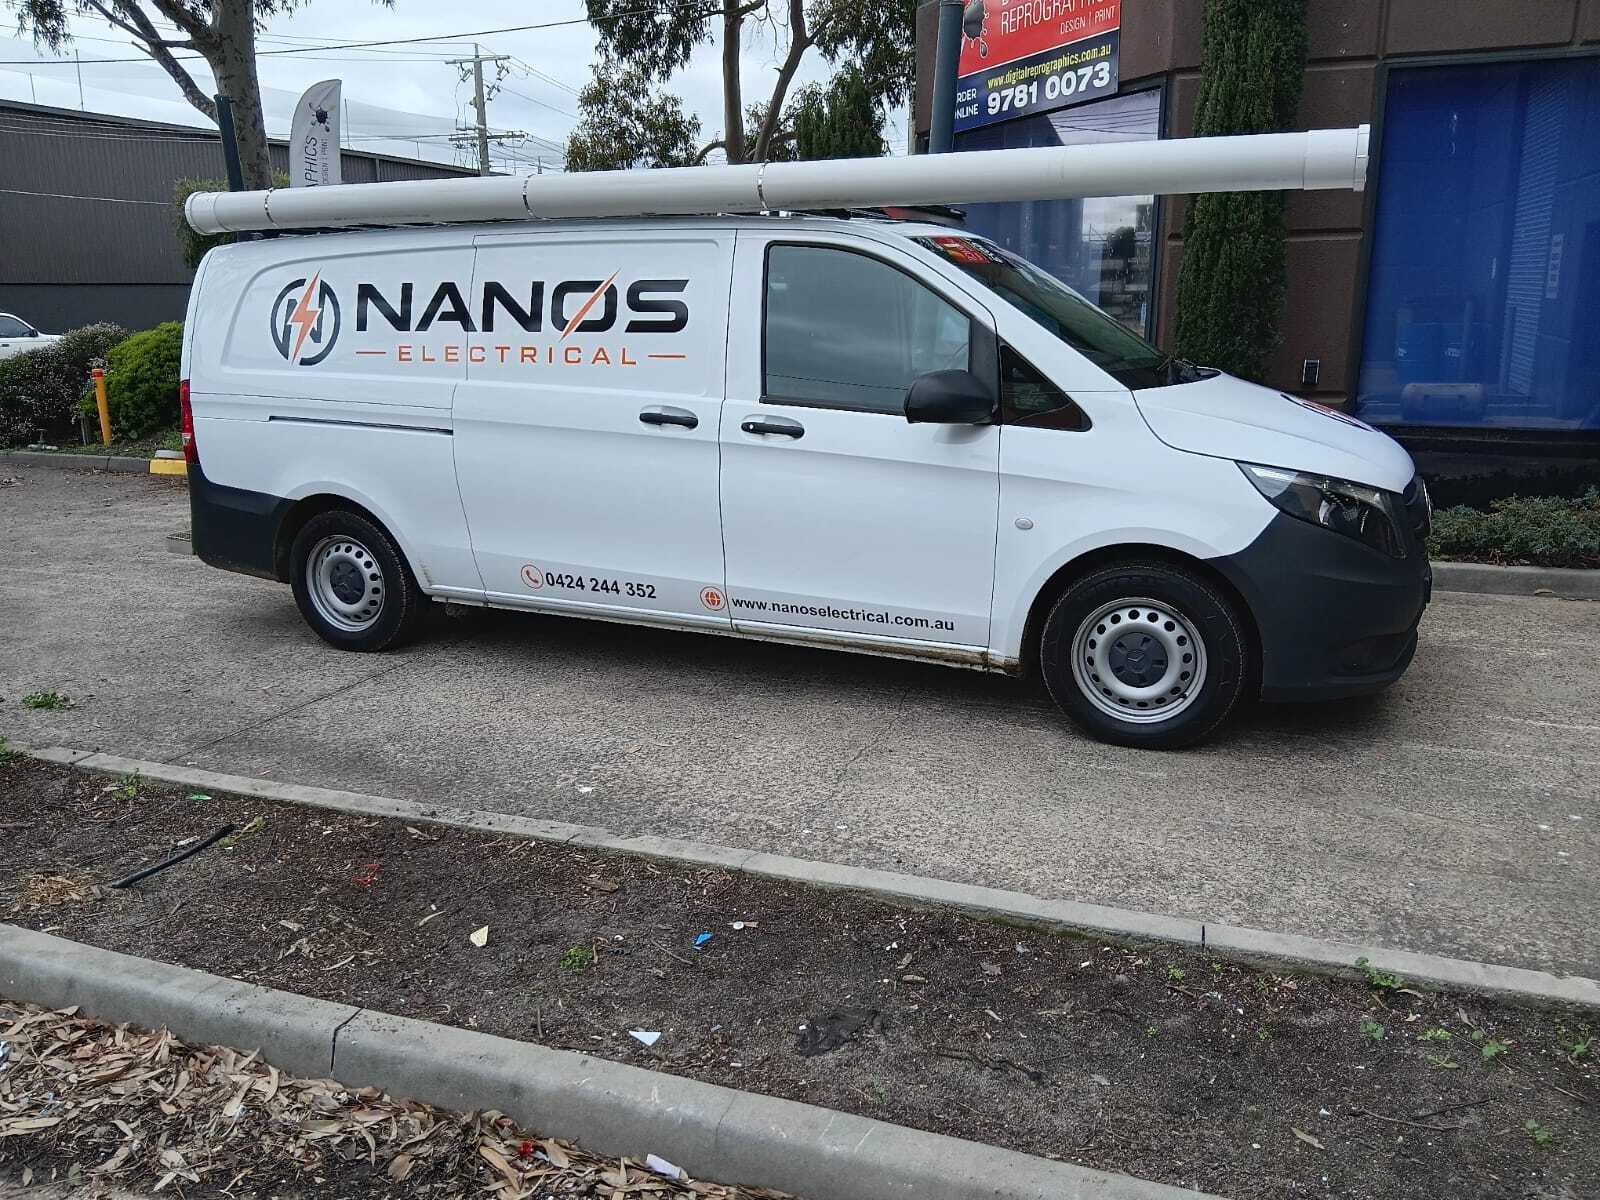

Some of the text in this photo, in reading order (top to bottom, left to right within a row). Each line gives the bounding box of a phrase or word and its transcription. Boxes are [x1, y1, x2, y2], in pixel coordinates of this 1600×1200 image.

[1001, 0, 1104, 36] REPROGRA
[1060, 5, 1116, 35] DESIGN PRINT
[987, 44, 1111, 88] www.digitalreprographics.com.au
[956, 87, 977, 104] RDER
[987, 61, 1110, 115] 9781 0073
[954, 103, 979, 120] NLINE
[356, 279, 690, 333] NANOS
[398, 345, 638, 366] ELECTRICAL
[545, 572, 657, 599] 0424 244 352
[731, 597, 955, 632] www.nanoselectrical.com.au
